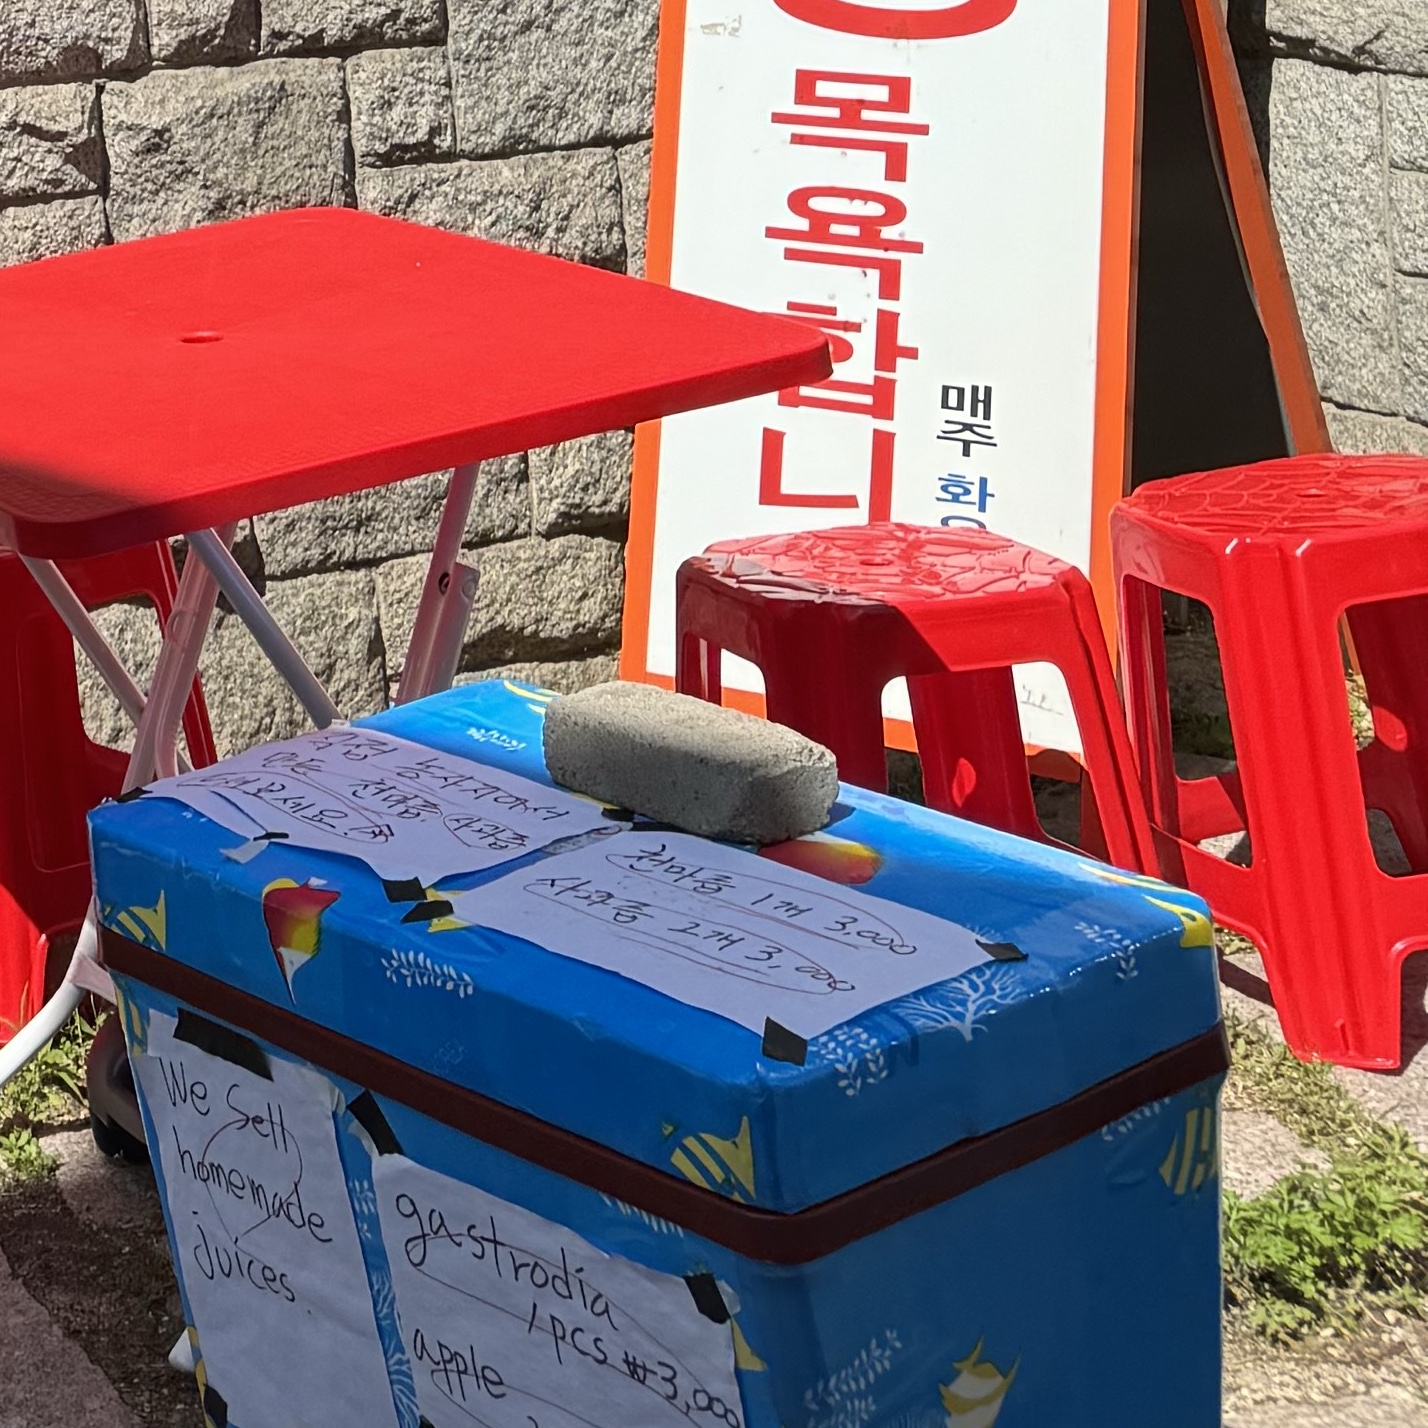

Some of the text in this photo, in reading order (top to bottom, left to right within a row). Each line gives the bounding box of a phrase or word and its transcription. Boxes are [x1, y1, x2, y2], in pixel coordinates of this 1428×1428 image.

[936, 381, 998, 458] 매주
[534, 876, 654, 924] 사과즙
[745, 945, 855, 992] 3,000
[630, 844, 736, 895] 천마즙
[824, 914, 918, 956] 3,000
[159, 1056, 211, 1117] We
[396, 1193, 618, 1330] gastrodia
[412, 1326, 506, 1399] apple
